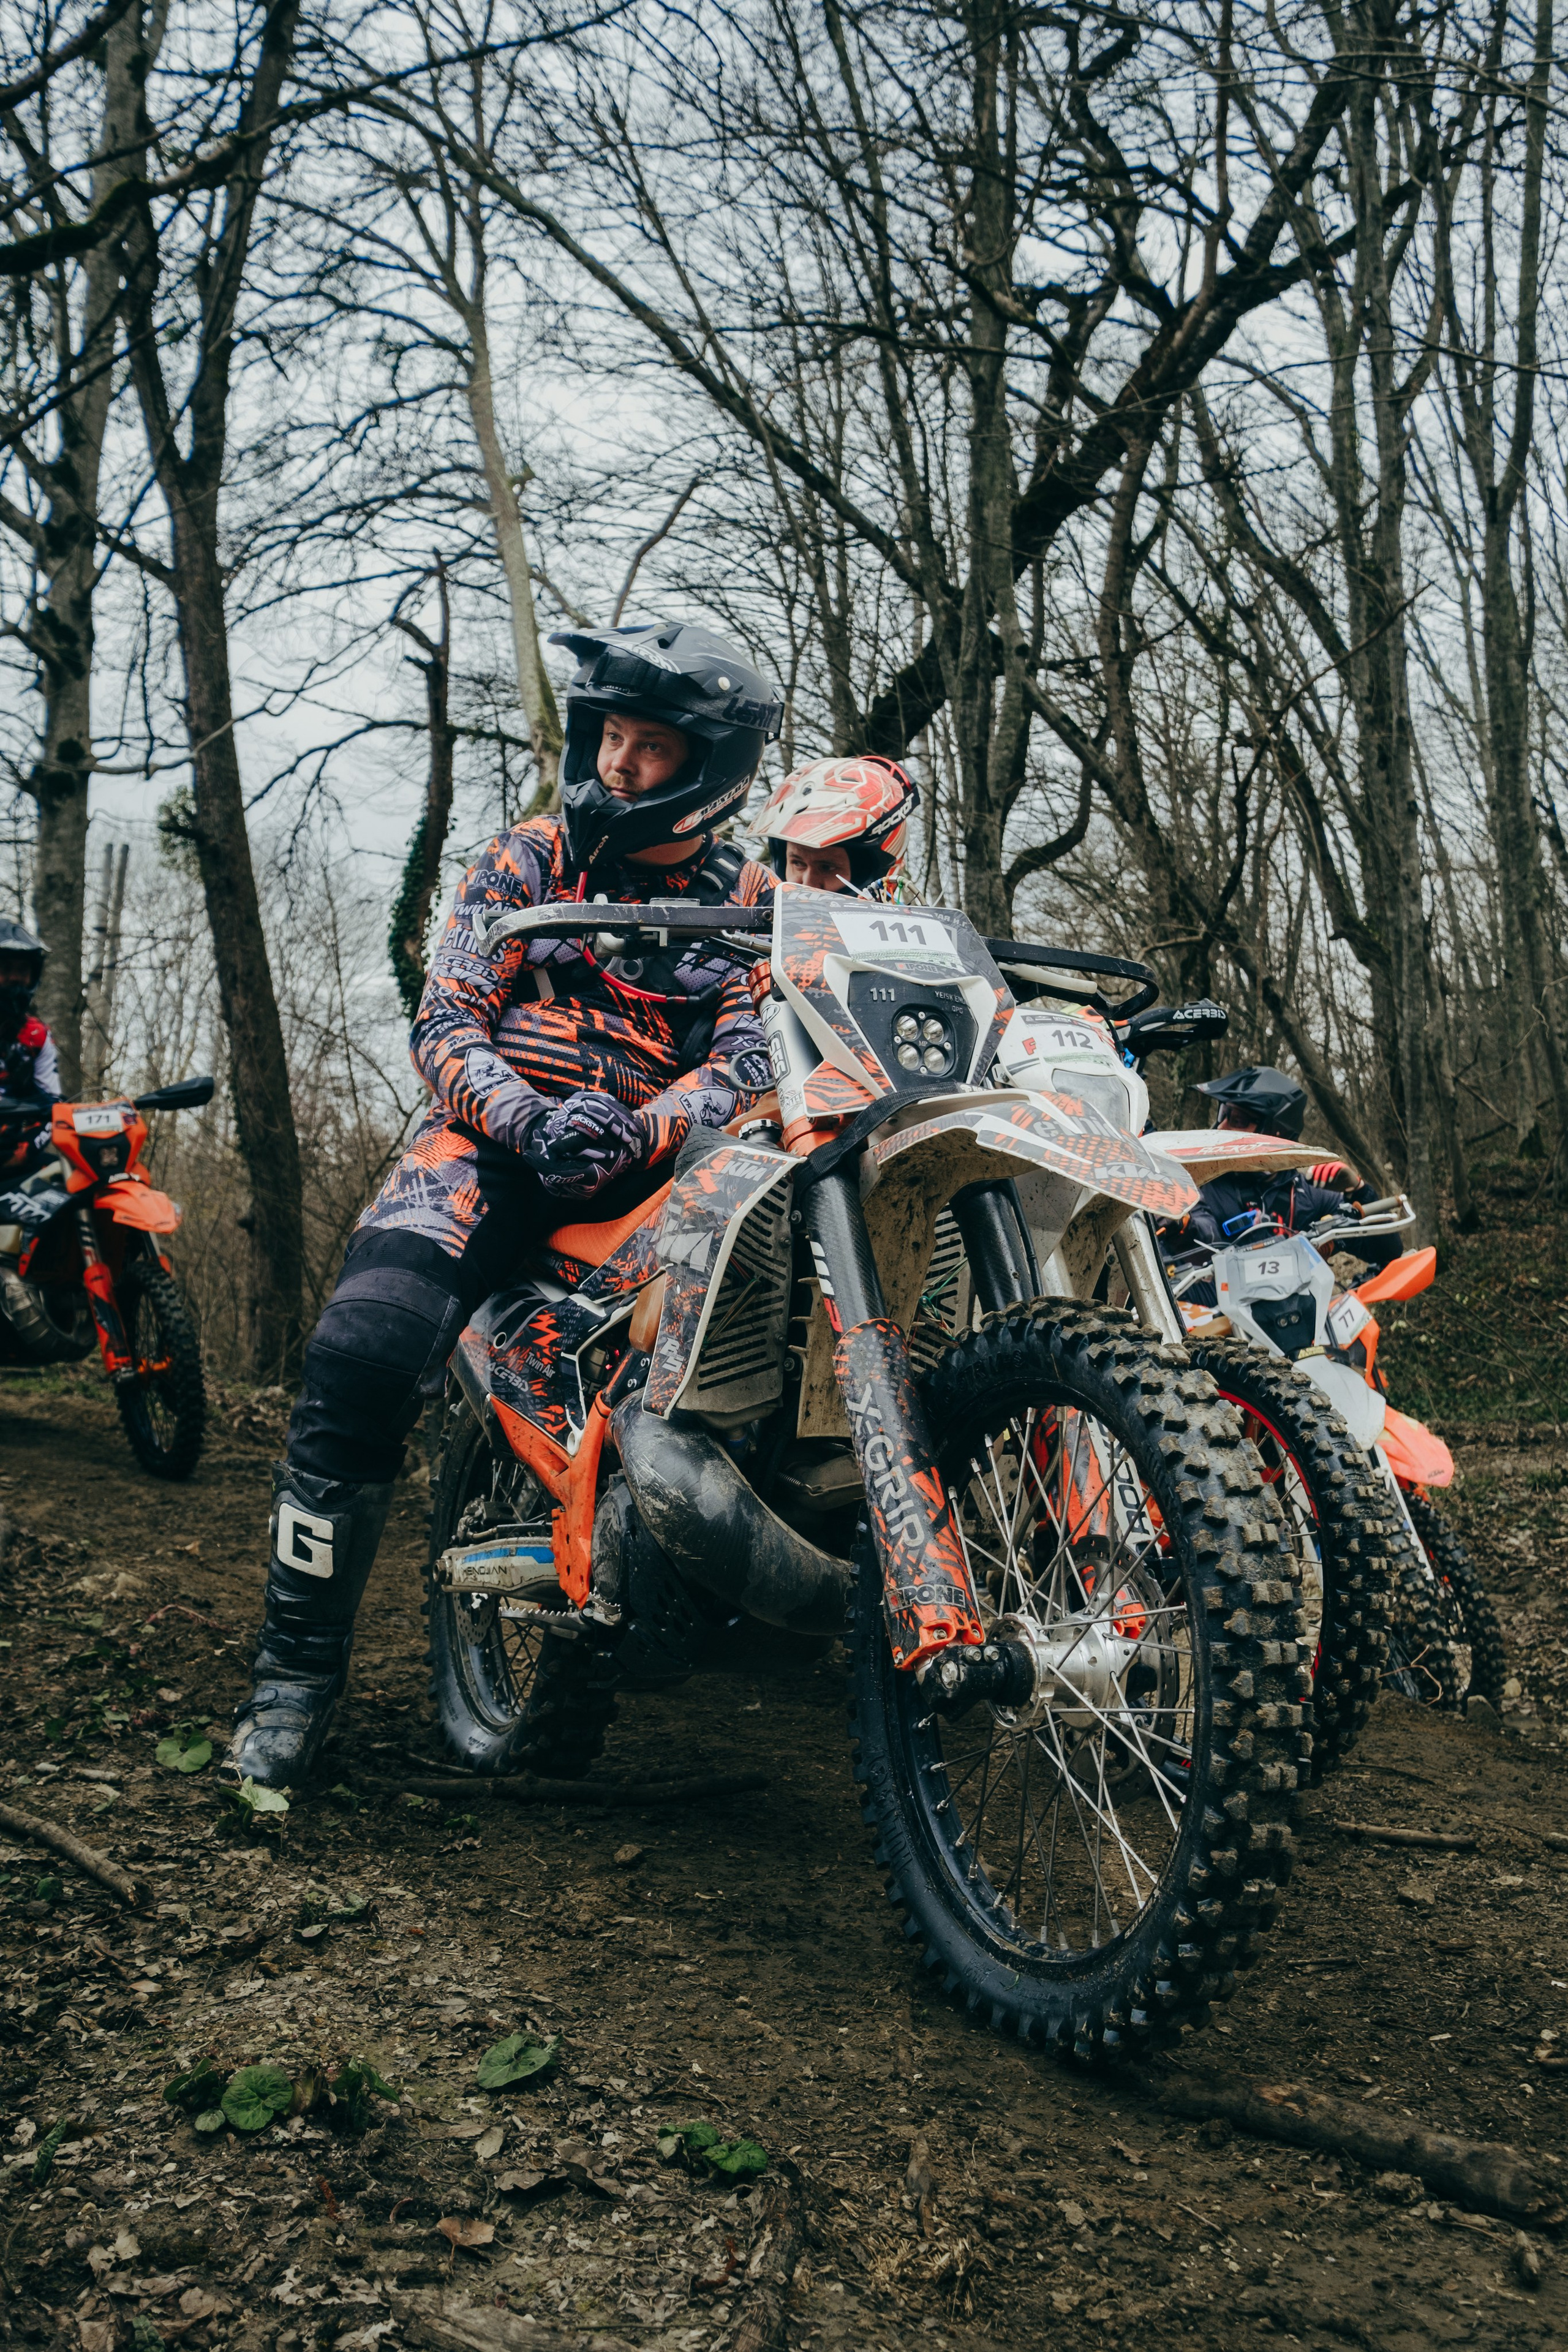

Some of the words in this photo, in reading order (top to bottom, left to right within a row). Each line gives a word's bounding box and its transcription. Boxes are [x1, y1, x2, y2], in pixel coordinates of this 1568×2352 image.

[589, 834, 609, 865] Airoh
[869, 920, 927, 946] 111
[905, 963, 938, 973] IPONE
[870, 987, 896, 1001] 111
[1172, 1008, 1226, 1020] ACERBIS
[1052, 1030, 1093, 1050] 112
[86, 1114, 111, 1125] 171
[721, 1158, 767, 1182] KTM
[1257, 1261, 1280, 1275] 13
[1338, 1308, 1355, 1328] 77
[525, 1351, 543, 1373] Twin
[543, 1363, 556, 1379] Air
[486, 1362, 529, 1392] ACERBIS
[846, 1382, 925, 1548] X-GRIP
[277, 1502, 334, 1579] G
